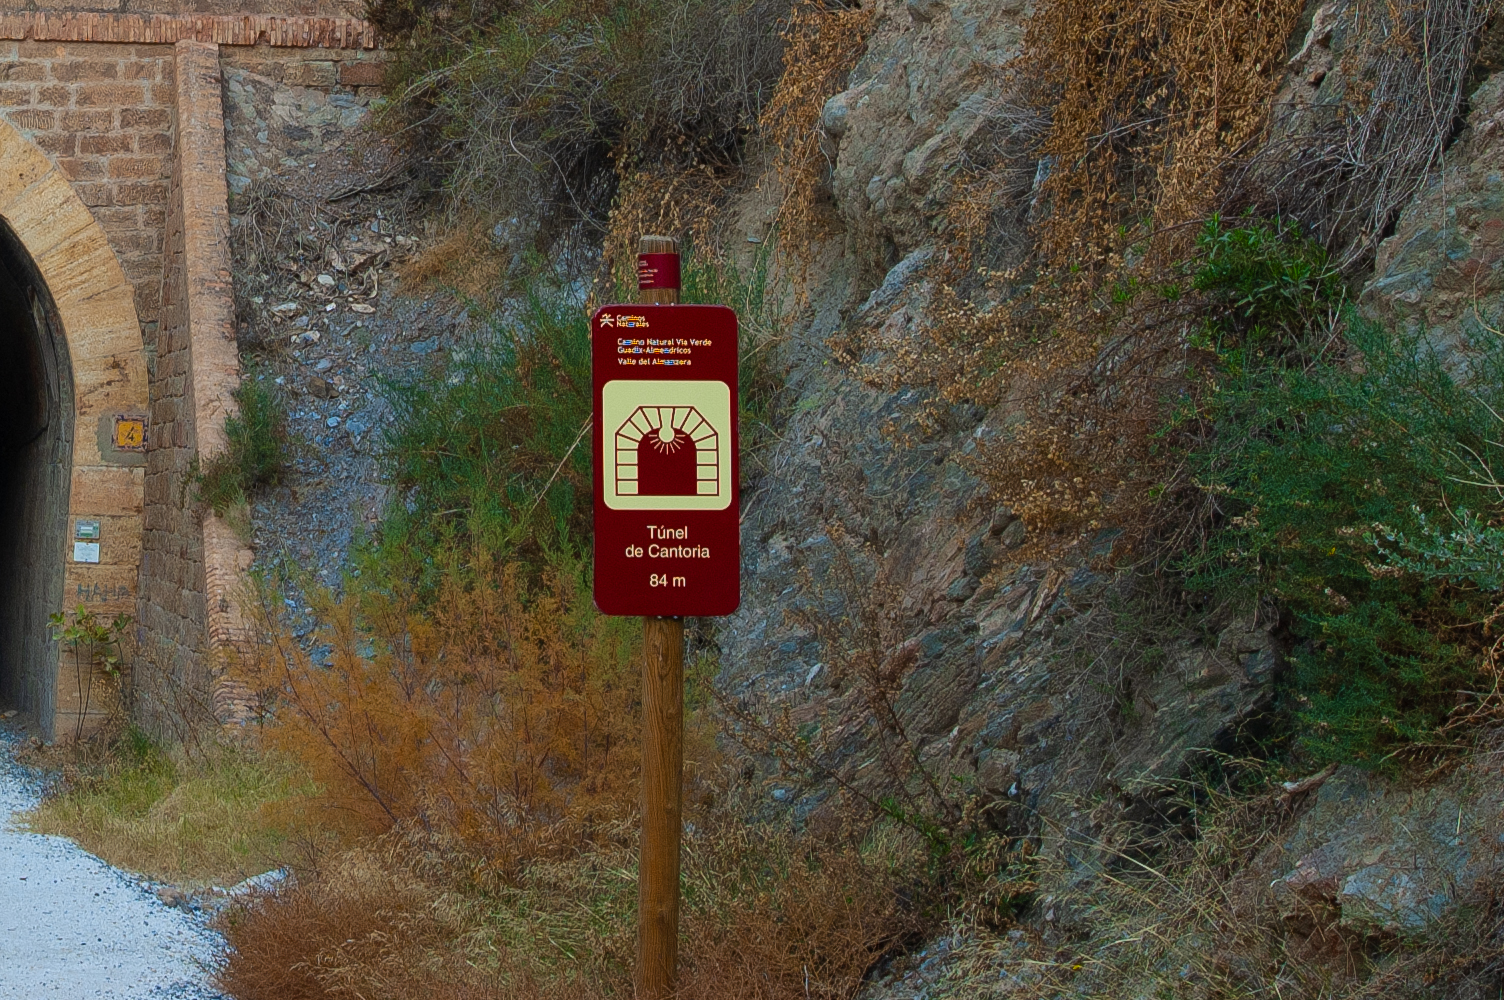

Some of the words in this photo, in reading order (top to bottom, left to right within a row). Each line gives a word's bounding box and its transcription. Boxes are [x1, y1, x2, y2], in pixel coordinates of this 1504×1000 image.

[616, 320, 649, 328] Naturales
[617, 337, 645, 346] Camino
[646, 337, 674, 346] Natural
[689, 337, 712, 346] Verde
[617, 357, 636, 366] Valle
[638, 357, 650, 366] del
[652, 357, 692, 366] Almanzora
[646, 525, 688, 540] Túnel
[625, 544, 644, 558] de
[648, 543, 710, 559] Cantoria
[649, 573, 668, 588] 84
[672, 576, 686, 588] m
